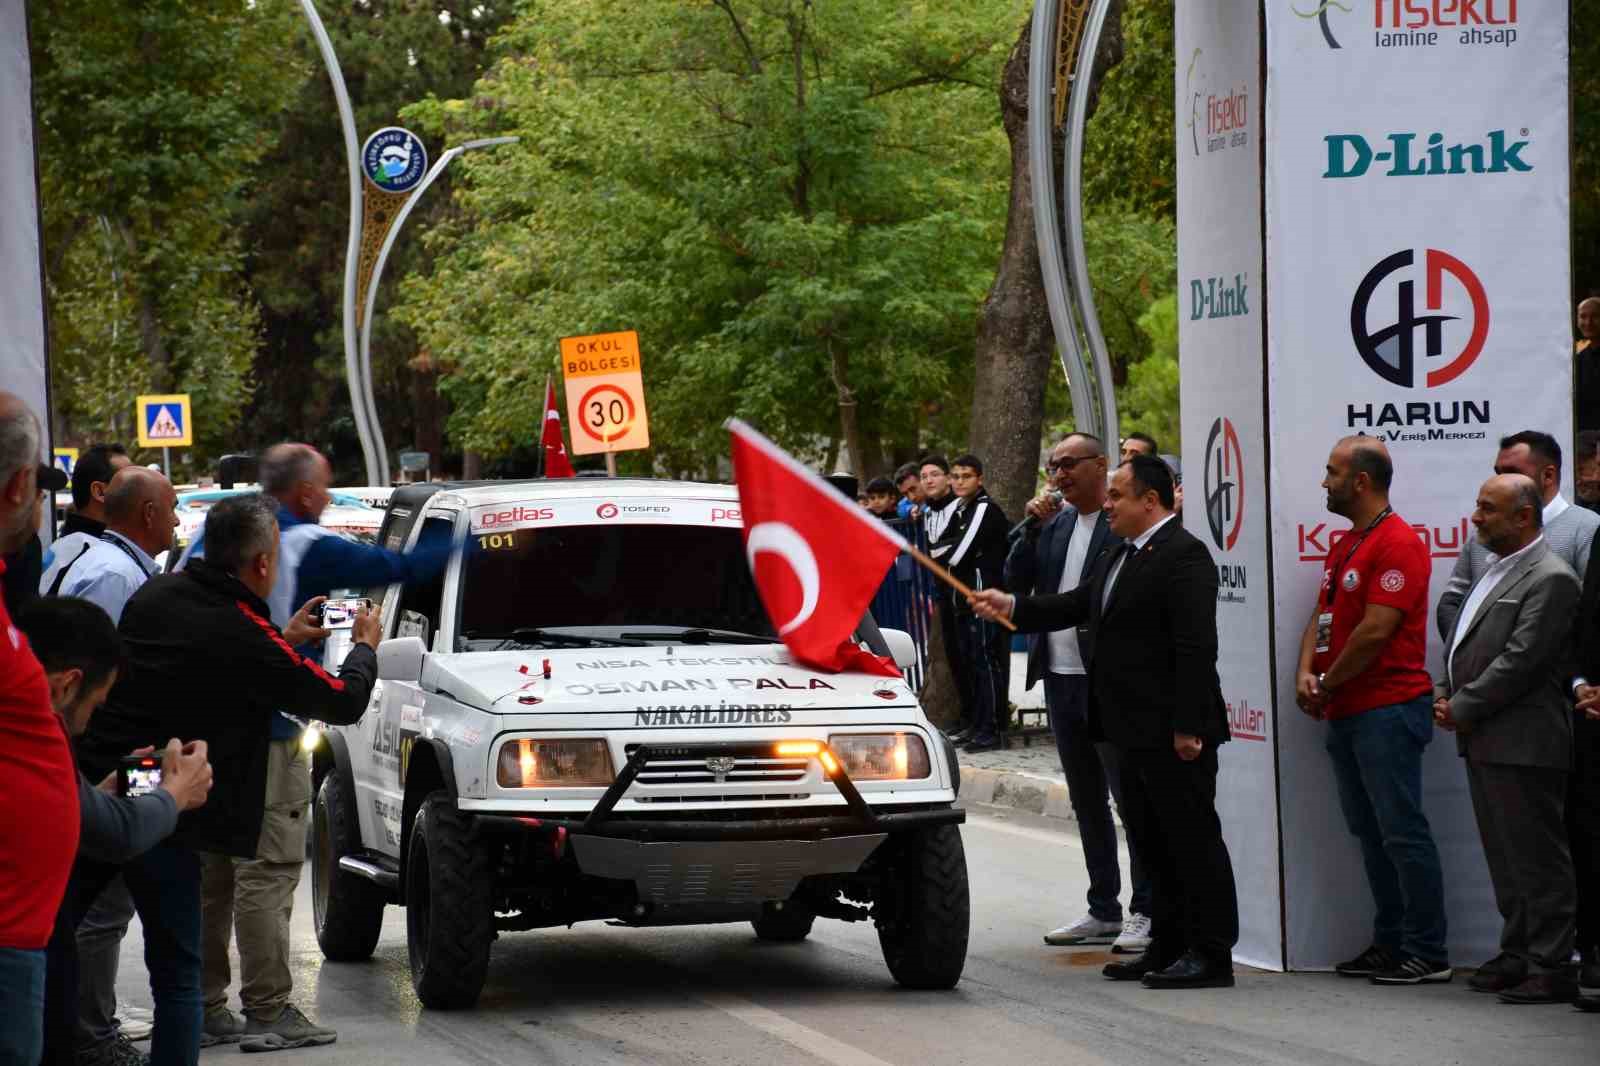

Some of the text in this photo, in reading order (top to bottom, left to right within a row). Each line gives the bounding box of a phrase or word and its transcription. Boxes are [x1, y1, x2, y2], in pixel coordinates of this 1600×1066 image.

[1376, 30, 1438, 47] lamine
[576, 339, 622, 354] OKUL
[590, 399, 625, 427] 30
[1347, 400, 1490, 427] HARUN
[481, 506, 554, 525] petlas
[478, 533, 513, 549] 101
[565, 677, 836, 696] OSMAN PALA
